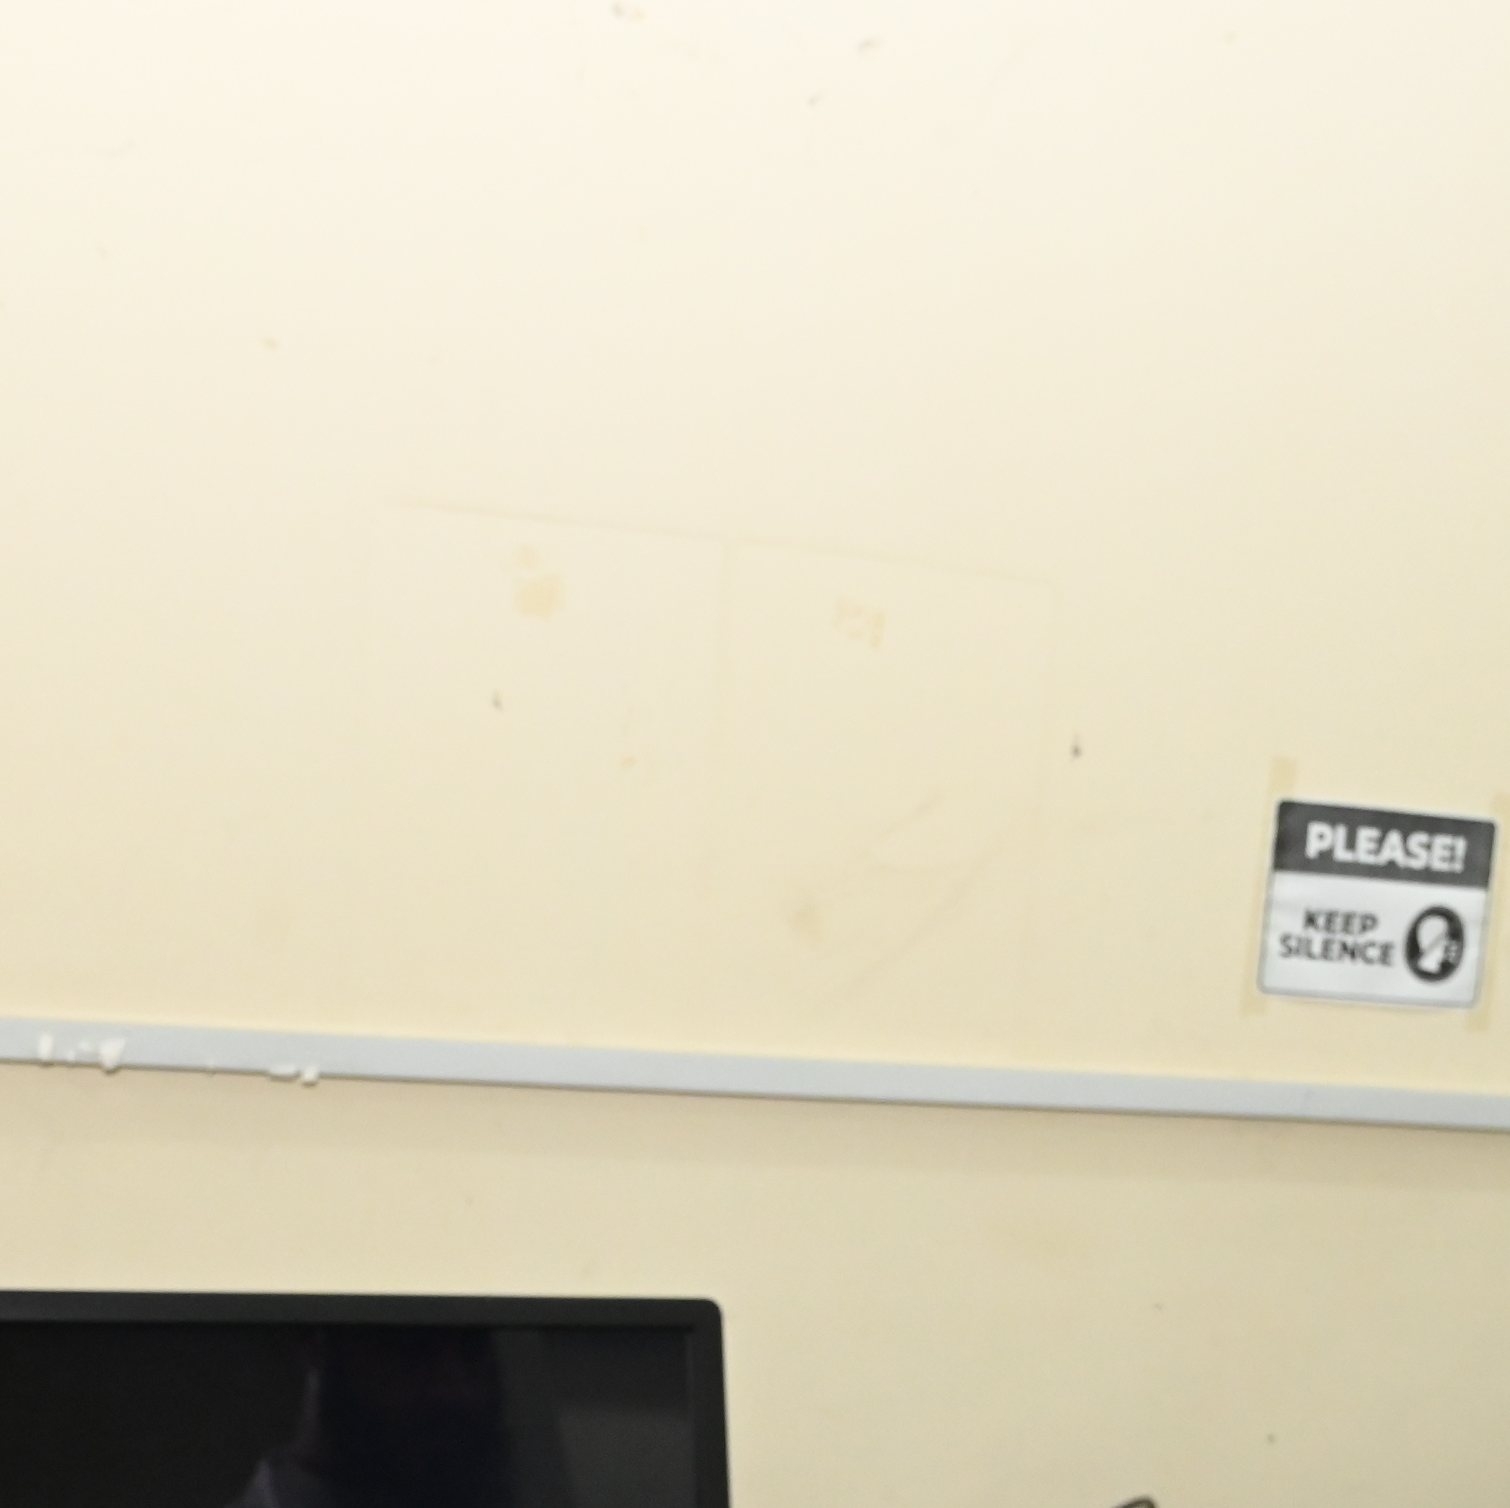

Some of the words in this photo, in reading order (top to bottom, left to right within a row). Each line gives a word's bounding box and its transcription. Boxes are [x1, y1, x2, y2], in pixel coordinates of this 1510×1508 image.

[1304, 820, 1468, 874] PLEASE!
[1303, 907, 1379, 935] KEEP
[1279, 932, 1395, 967] SILENCE
